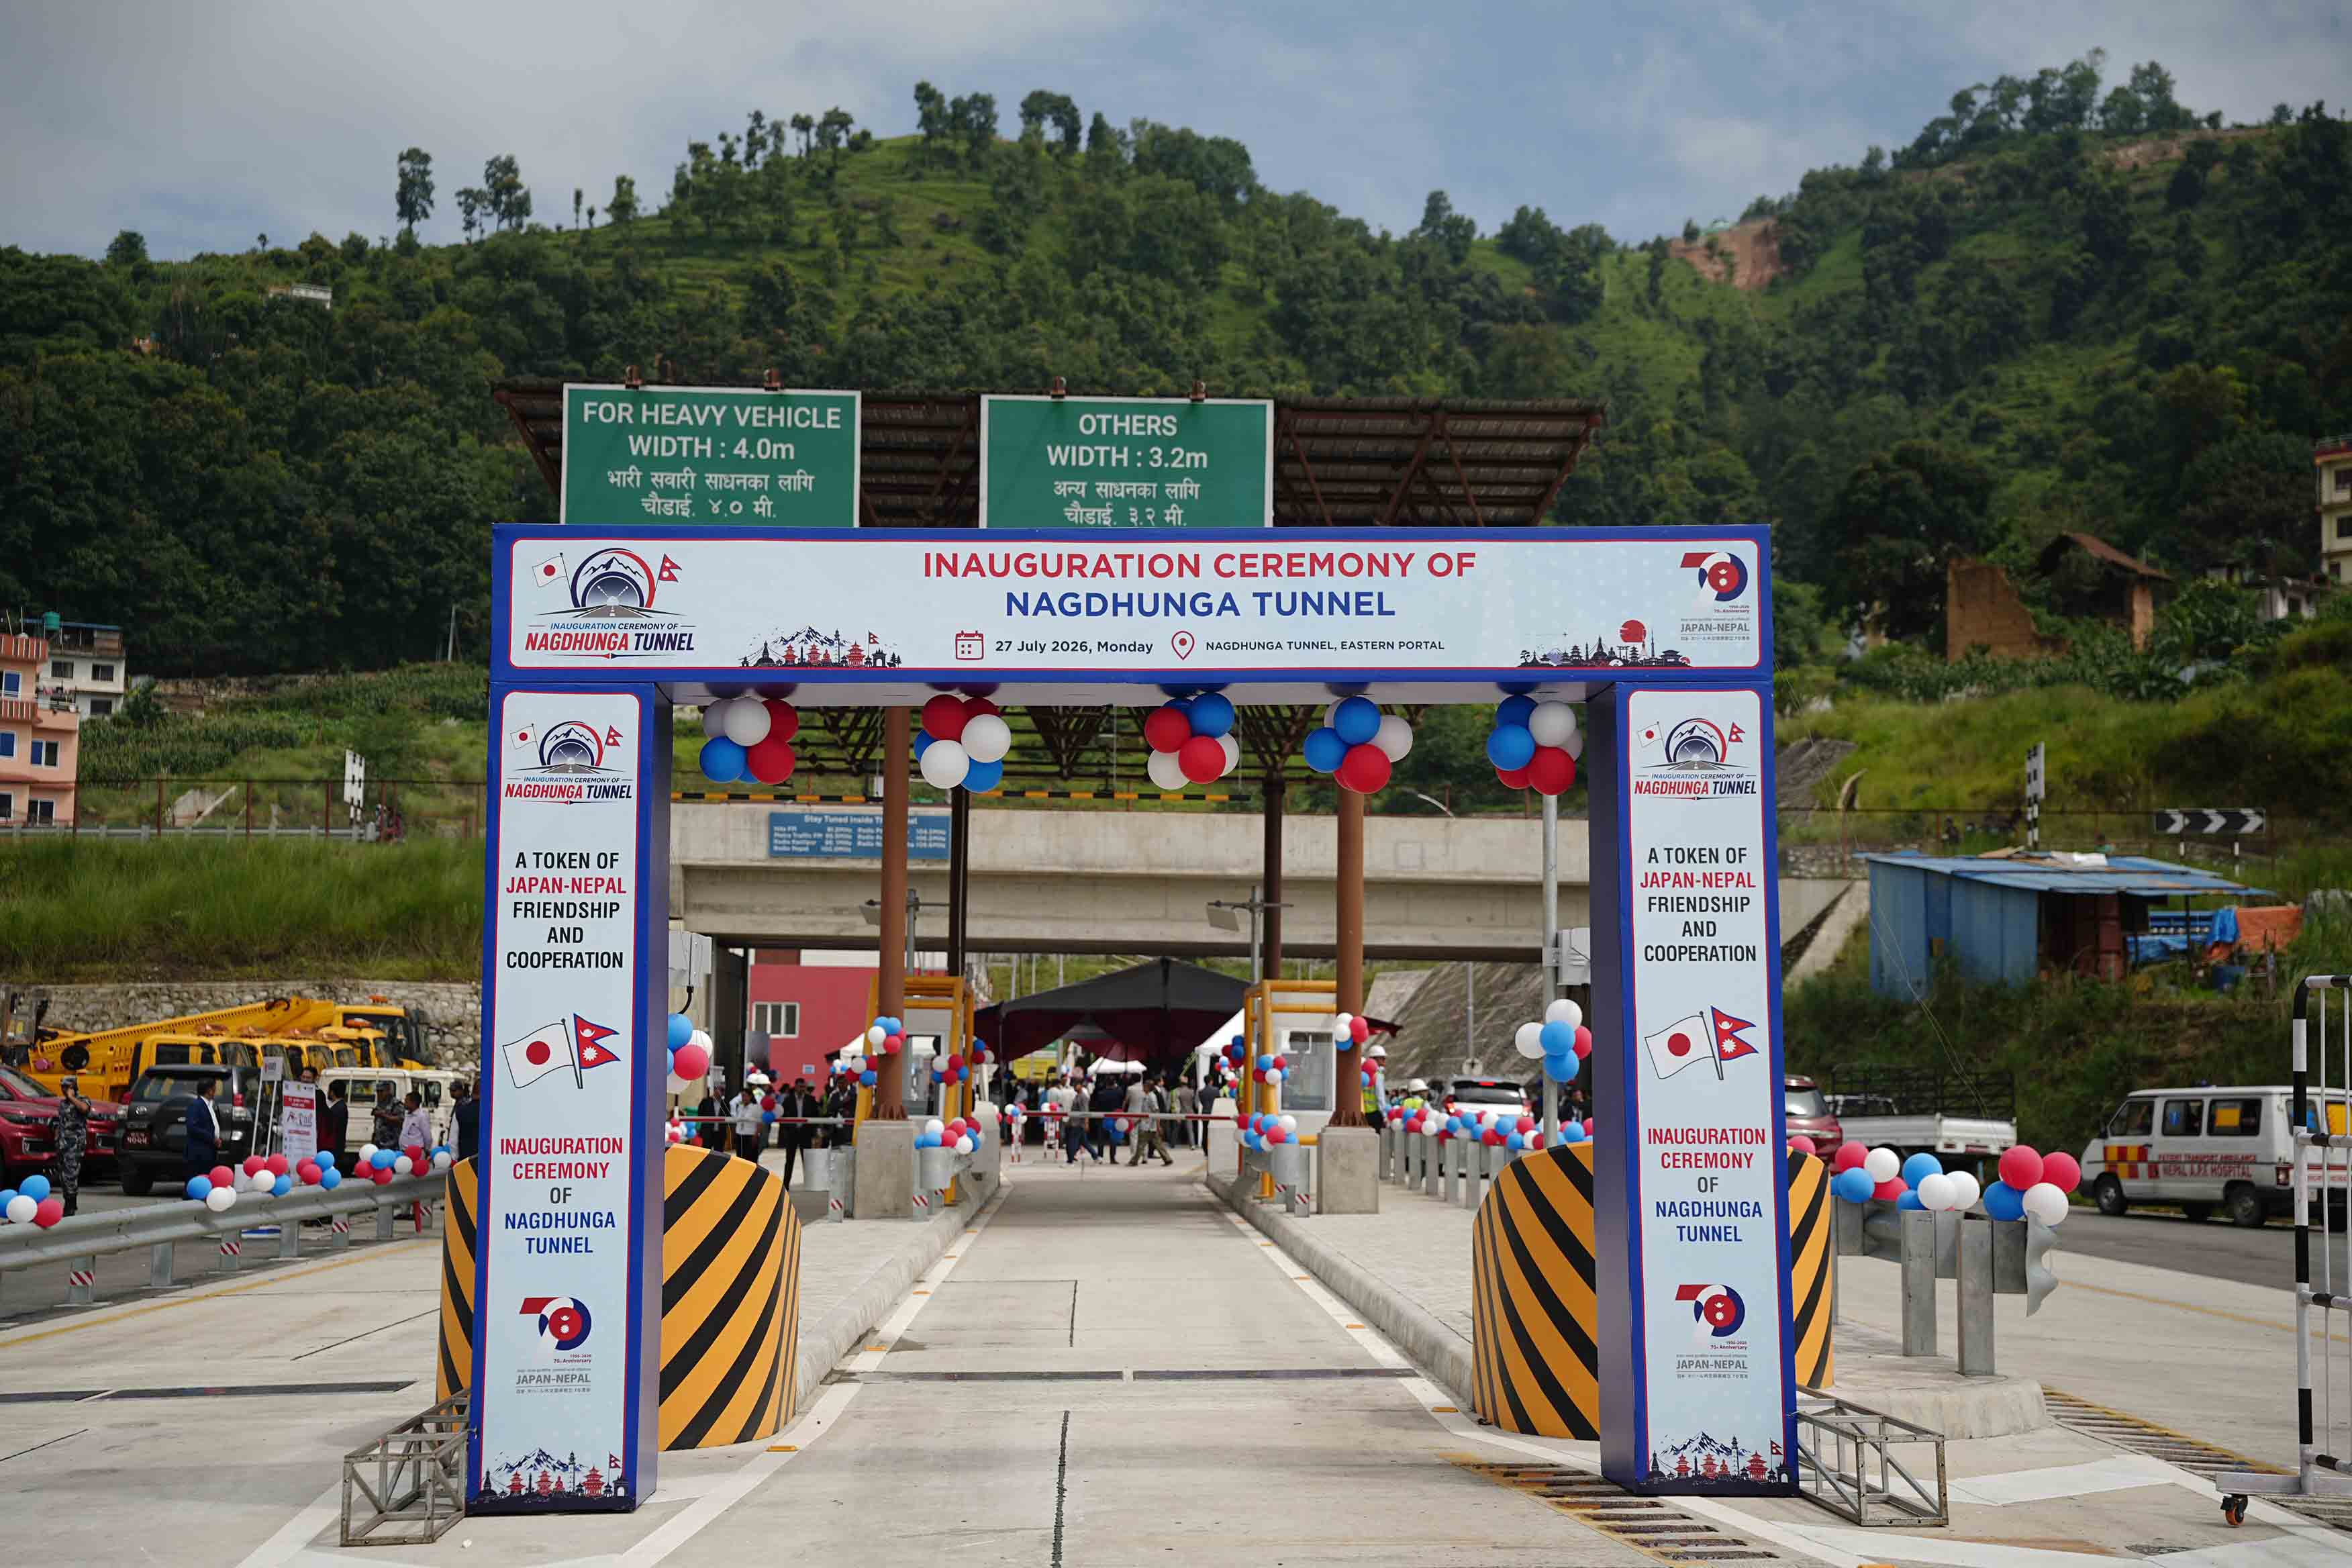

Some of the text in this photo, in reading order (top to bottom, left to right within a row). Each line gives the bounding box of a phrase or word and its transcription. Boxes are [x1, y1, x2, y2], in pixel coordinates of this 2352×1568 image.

[584, 402, 840, 428] FOR HEAVY VEHICLE
[1079, 414, 1177, 436] OTHERS
[628, 435, 711, 458] WIDTH
[733, 438, 794, 459] 4.0m
[1047, 446, 1128, 467] WIDTH
[1149, 447, 1207, 468] 3.2m
[607, 465, 815, 491] भारी सवारी साधनका लागि
[1054, 478, 1200, 499] अन्य साधनका लागि
[925, 552, 1475, 578] INAUGURATION CEREMONY OF
[1007, 591, 1395, 617] NAGDHUNGA TUNNEL
[1681, 623, 1749, 632] JAPAN-NEPAL
[526, 633, 694, 650] NAGDHUNGA TUNNEL
[996, 641, 1153, 654] 27 July 2026, Monday
[1207, 641, 1444, 650] NAGDHUNGA TUNNEL, EASTERN PORTAL
[505, 783, 632, 799] NAGDHUNGA TUNNEL
[1634, 781, 1756, 794] NAGDHUNGA TUNNEL
[824, 816, 849, 824] Tuned
[516, 852, 619, 869] A TOKEN OF
[1649, 848, 1747, 864] A TOKEN OF
[506, 877, 626, 893] JAPAN-NEPAL
[1640, 872, 1756, 888] JAPAN-NEPAL
[513, 902, 620, 918] FRIENDSHIP
[1649, 897, 1750, 912] FRIENDSHIP
[547, 927, 583, 943] AND
[1682, 921, 1716, 936] AND
[507, 952, 623, 968] COOPERATION
[1645, 945, 1756, 961] COOPERATION
[1649, 1128, 1765, 1144] INAUGURATION
[501, 1138, 622, 1155] INAUGURATION
[1661, 1153, 1753, 1169] CEREMONY
[513, 1163, 609, 1179] CEREMONY
[1698, 1177, 1718, 1193] OF
[550, 1187, 572, 1204] OF
[1657, 1202, 1762, 1217] NAGDHUNGA
[505, 1212, 615, 1229] NAGDHUNGA
[1677, 1226, 1743, 1242] TUNNEL
[526, 1237, 593, 1254] TUNNEL
[1676, 1359, 1748, 1369] JAPAN-NEPAL
[516, 1373, 591, 1384] JAPAN-NEPAL
